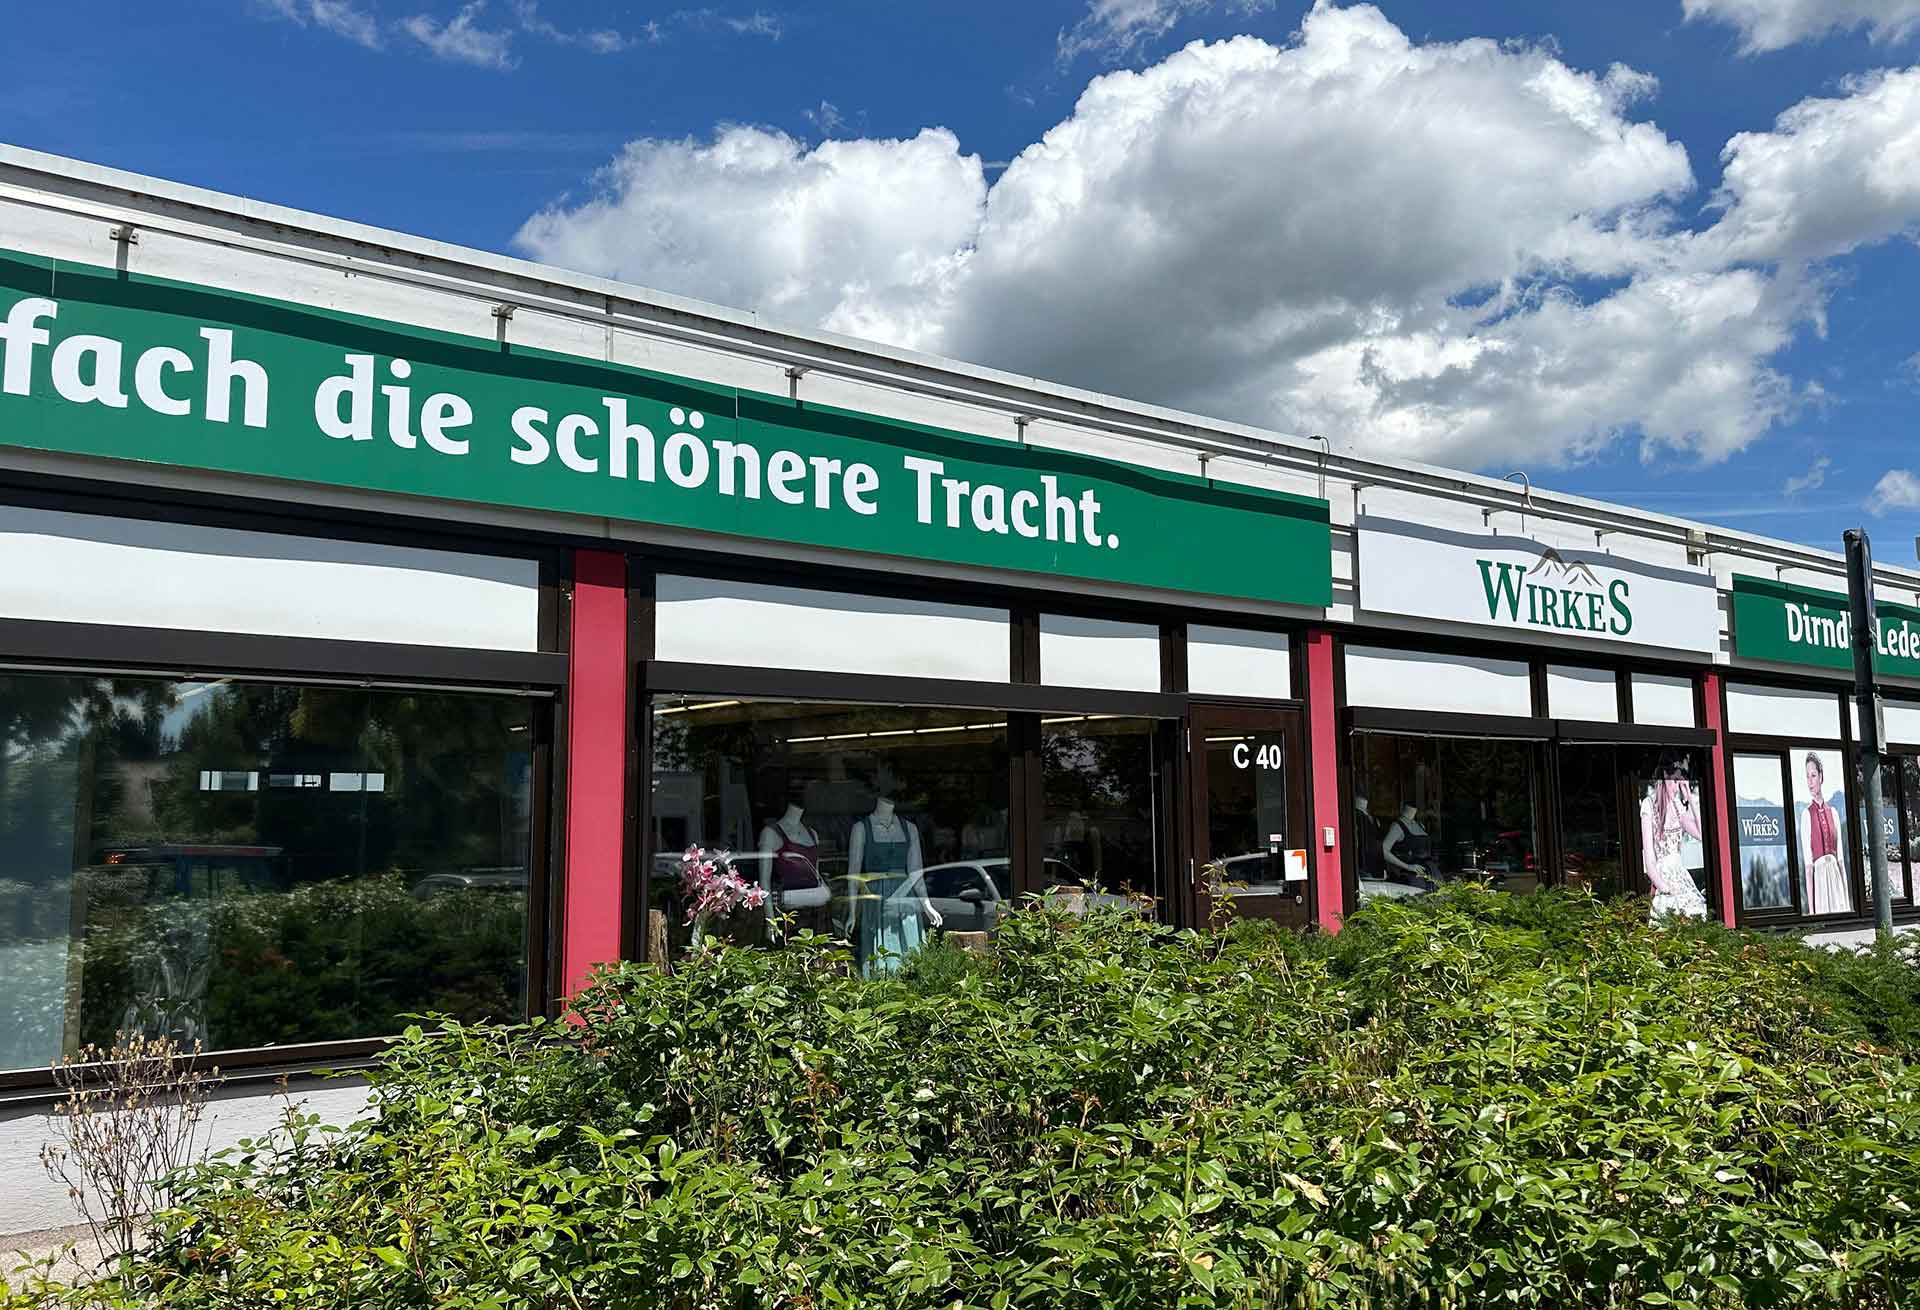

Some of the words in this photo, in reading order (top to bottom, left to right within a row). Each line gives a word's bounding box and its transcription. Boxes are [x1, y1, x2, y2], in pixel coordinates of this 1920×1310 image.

[0, 297, 269, 428] fach
[314, 353, 473, 455] die
[510, 396, 879, 515] schönere
[904, 455, 1119, 549] Tracht.
[1476, 559, 1633, 636] WIRKES
[1875, 617, 1920, 660] Lede
[1233, 743, 1250, 769] C
[1255, 744, 1282, 770] 40
